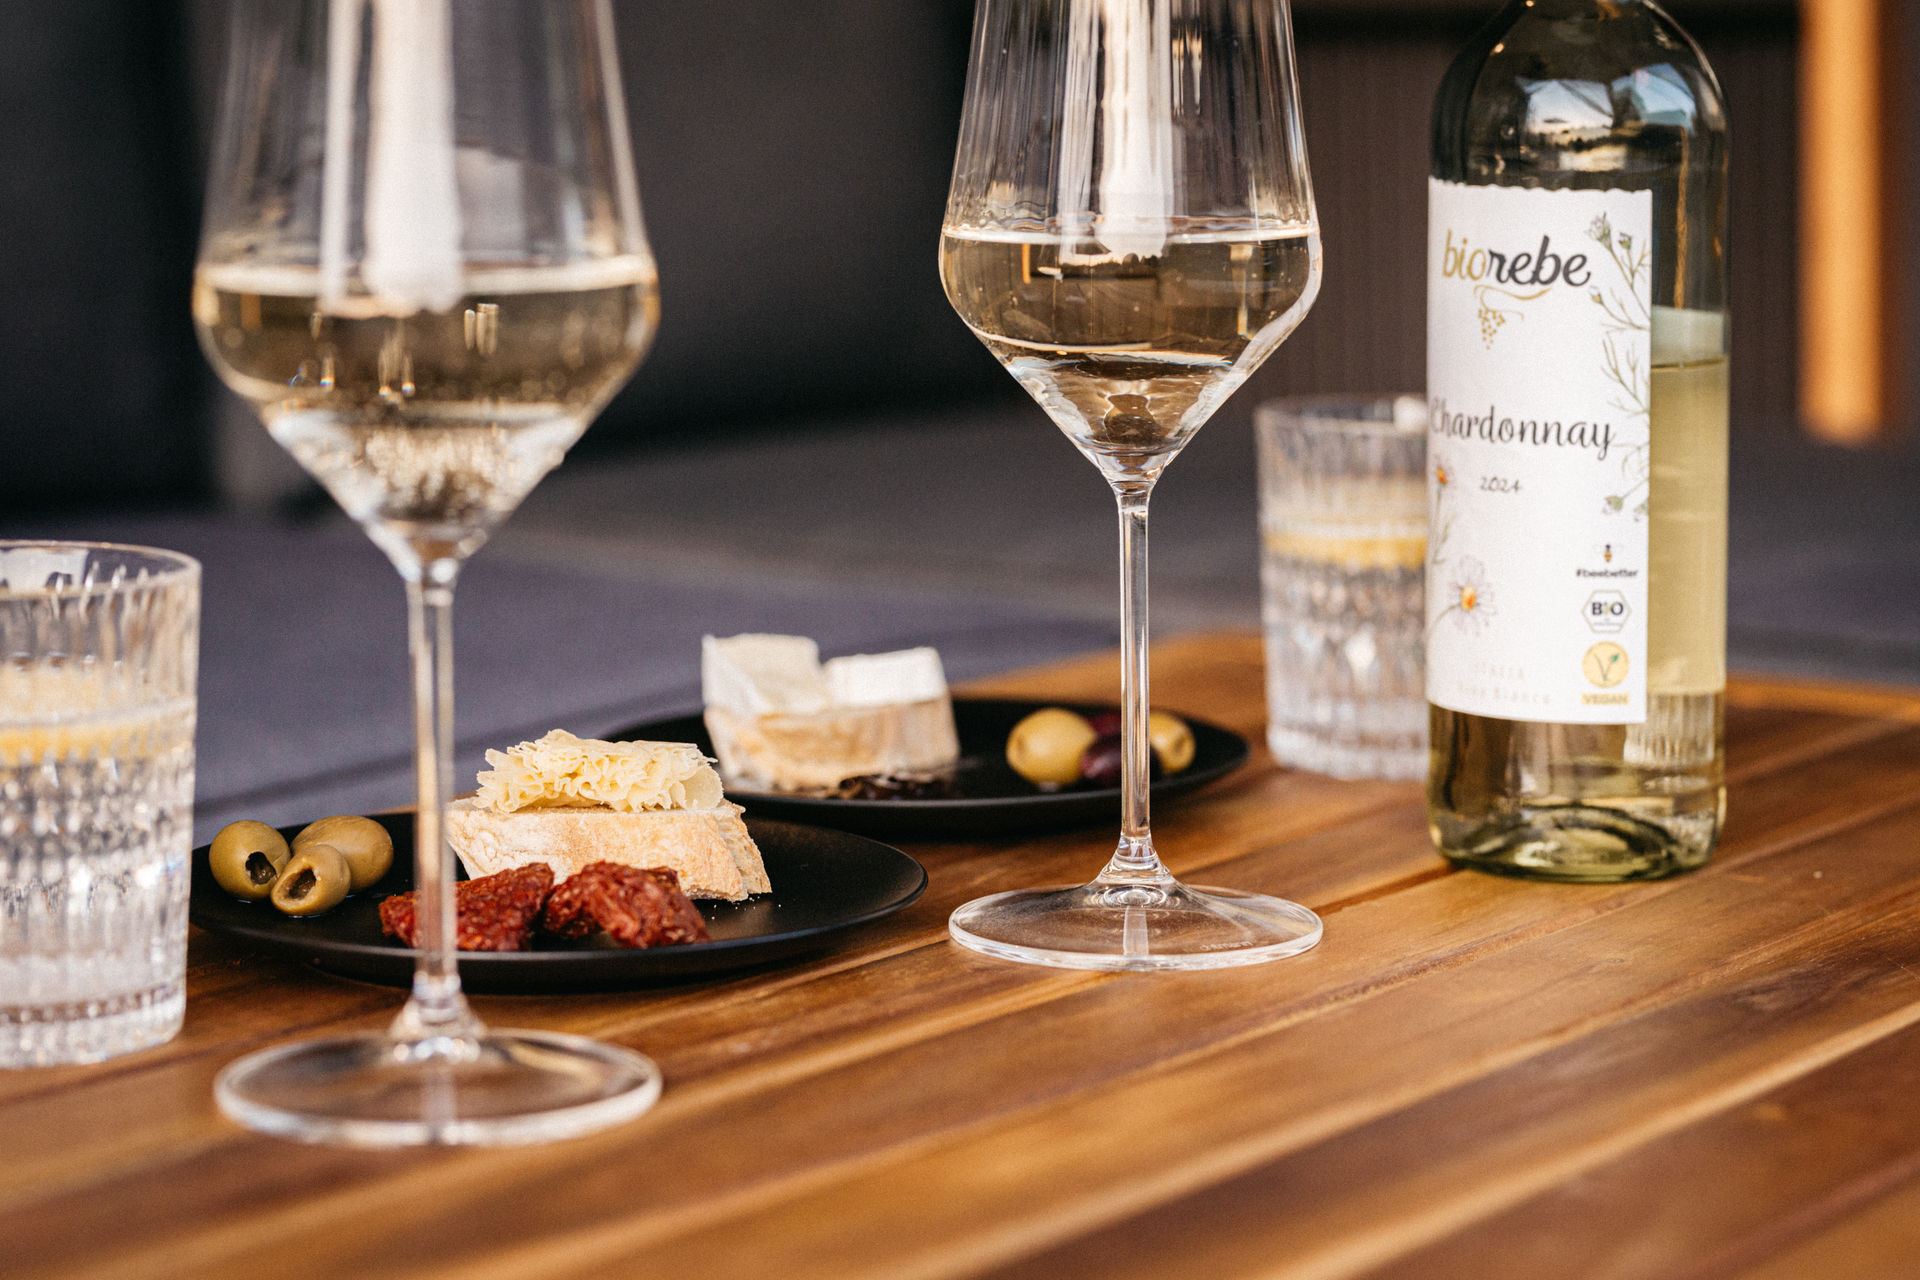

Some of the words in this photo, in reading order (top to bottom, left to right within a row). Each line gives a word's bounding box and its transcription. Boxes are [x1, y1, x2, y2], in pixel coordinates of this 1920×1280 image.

[1442, 229, 1592, 287] biorebe
[1430, 397, 1616, 461] Chardonnay
[1480, 476, 1522, 493] 2024
